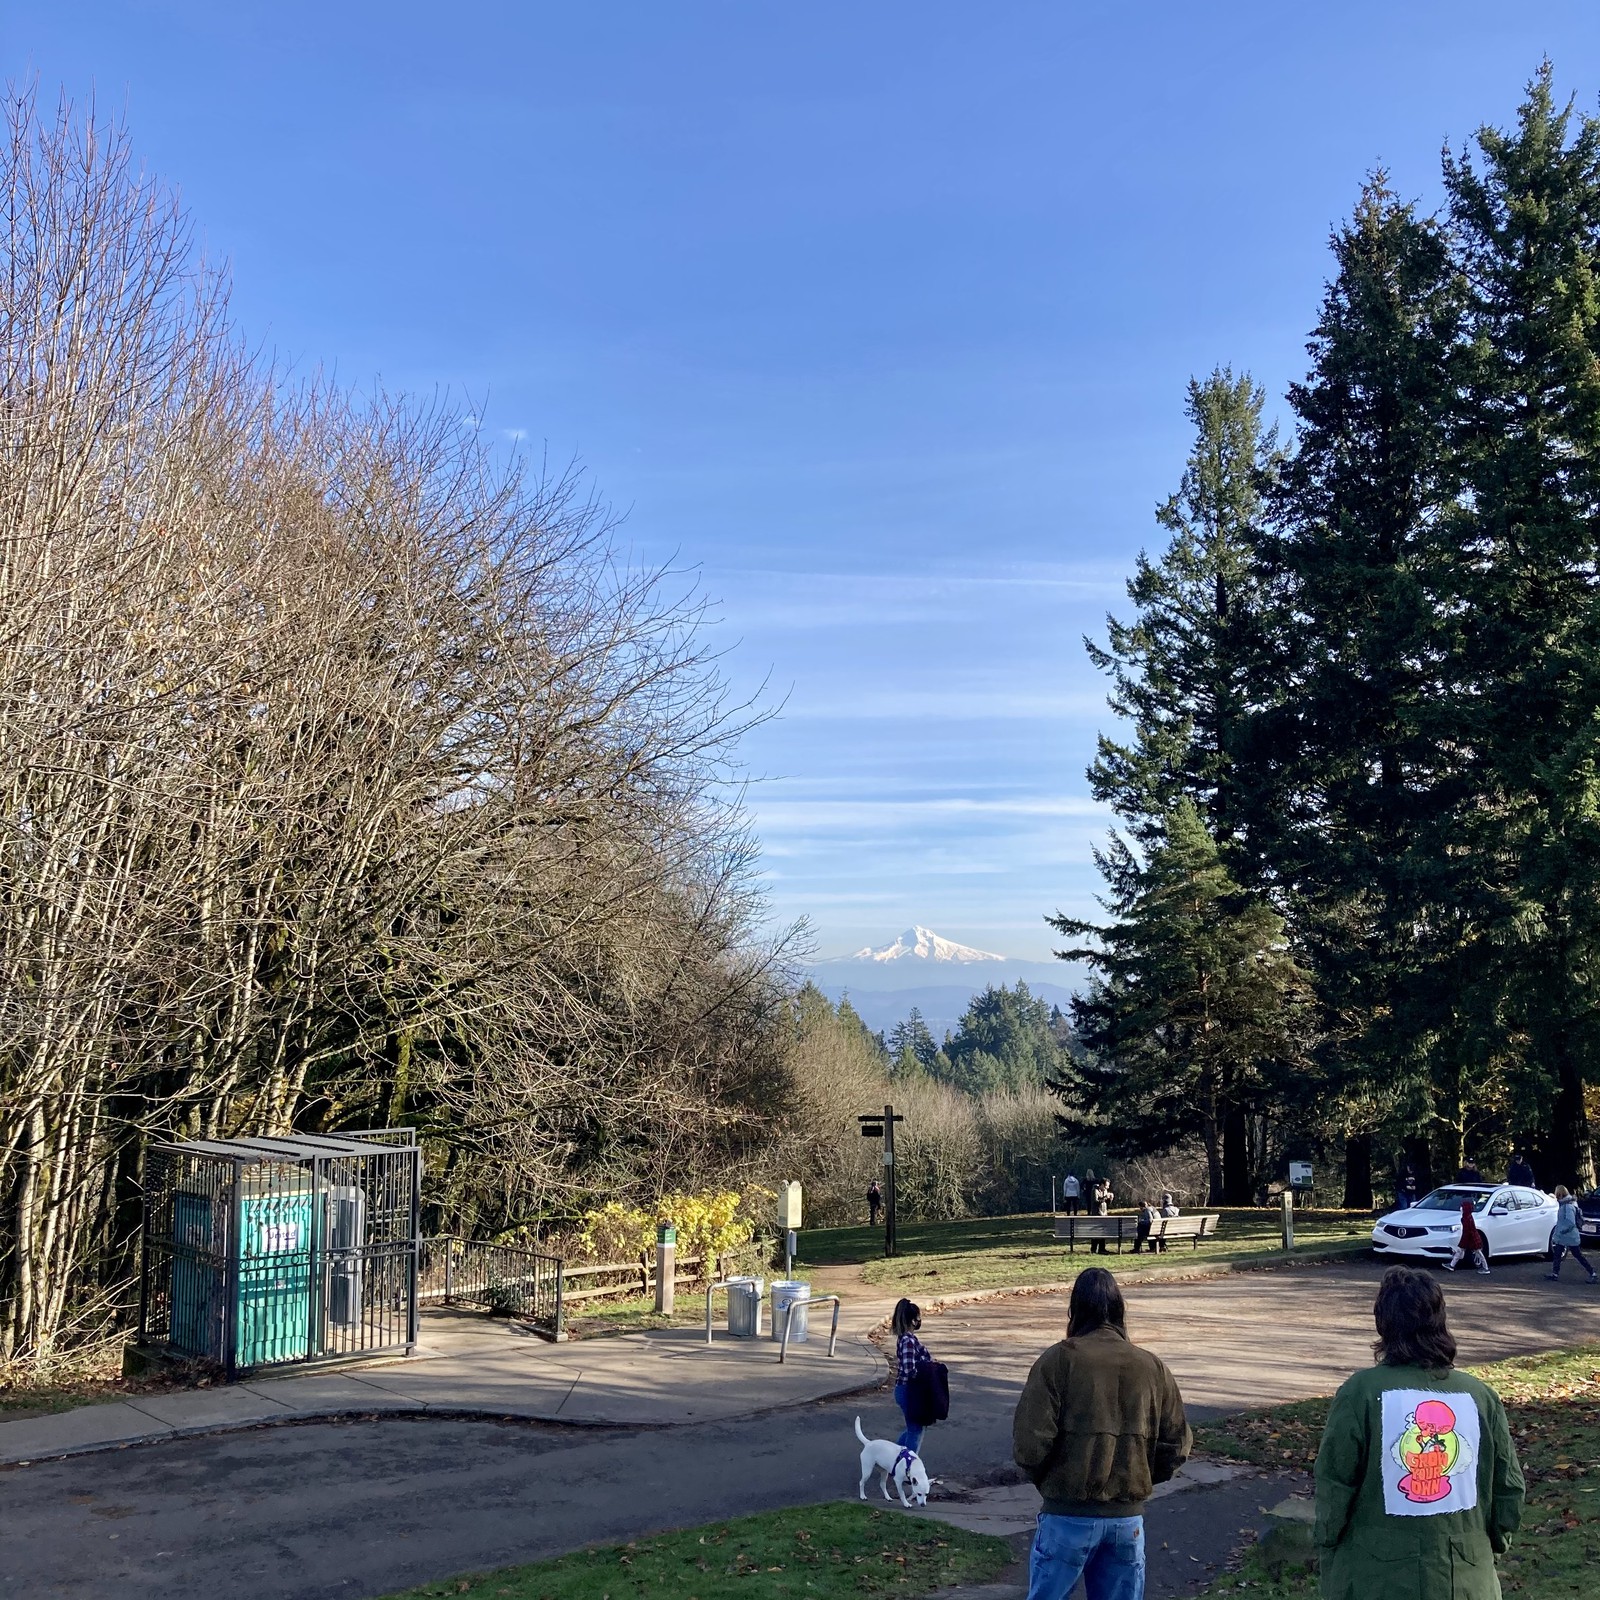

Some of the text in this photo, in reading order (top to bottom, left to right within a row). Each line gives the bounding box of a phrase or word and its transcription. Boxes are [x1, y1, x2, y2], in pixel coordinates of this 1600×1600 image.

[1405, 1451, 1448, 1468] GROW
[1411, 1467, 1443, 1480] YOUR
[1411, 1479, 1441, 1496] OWN
